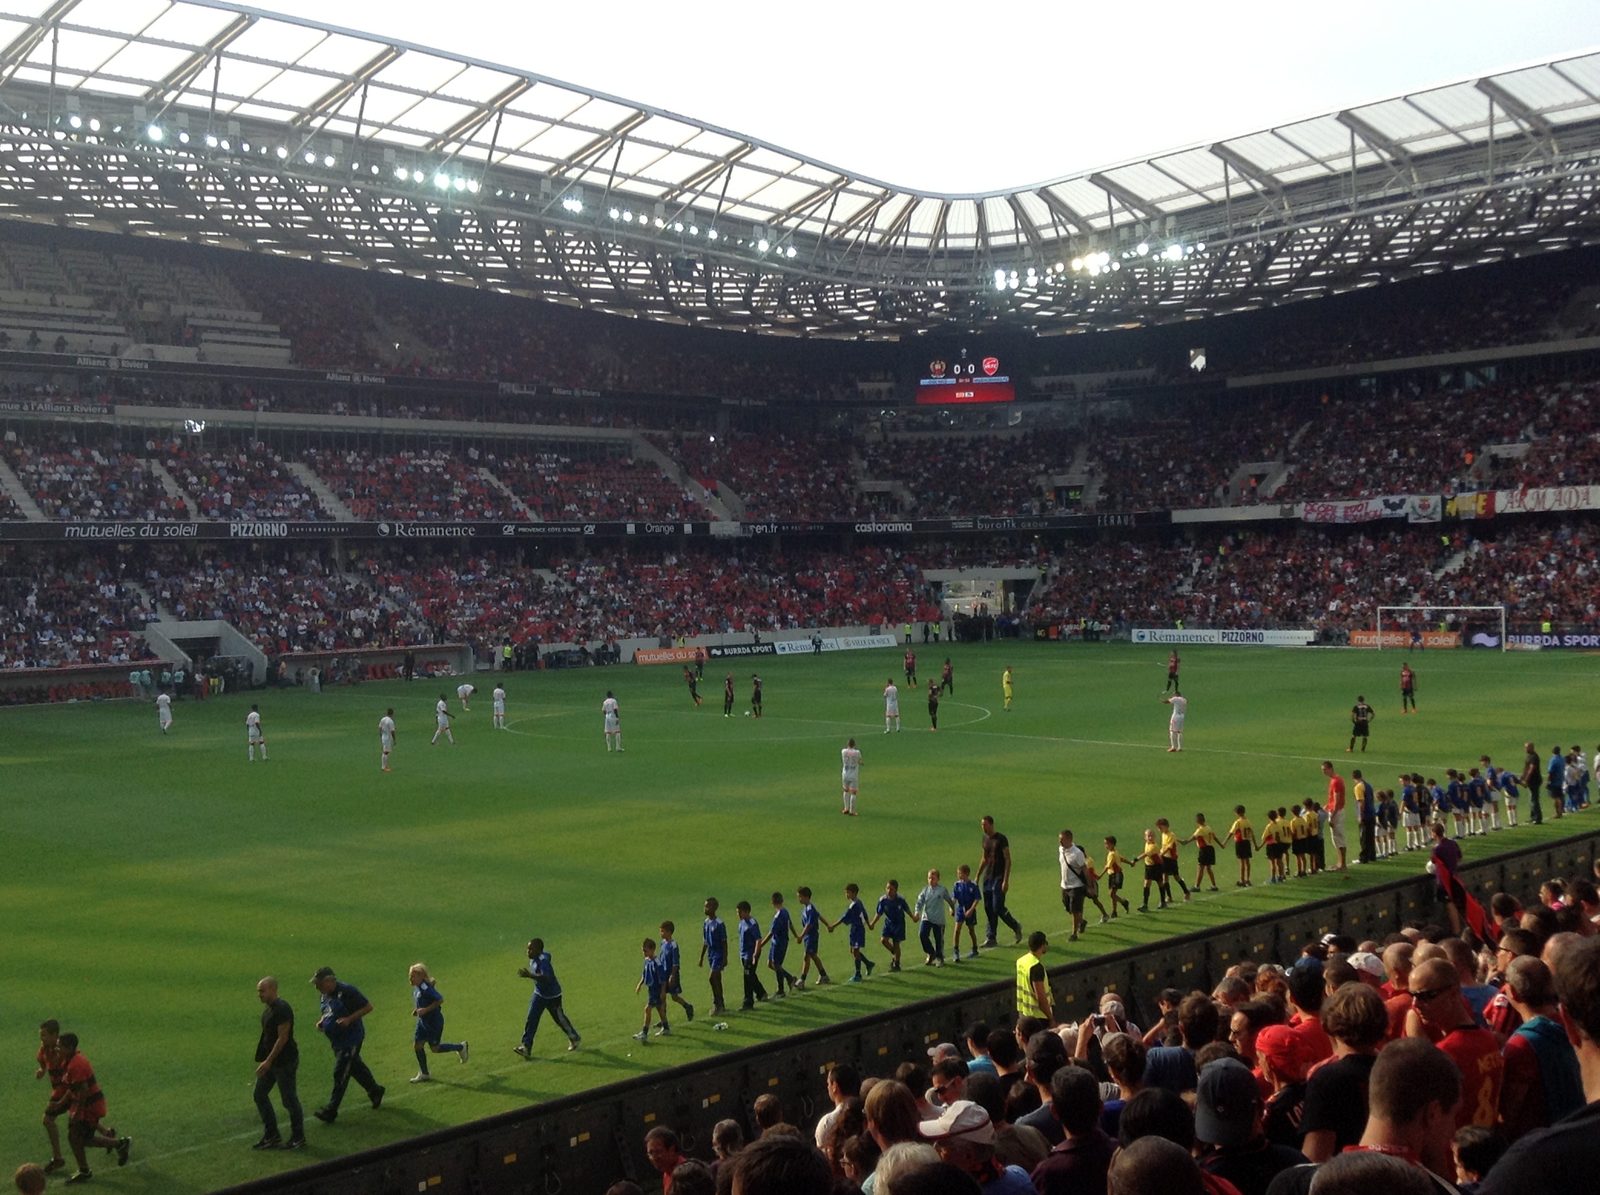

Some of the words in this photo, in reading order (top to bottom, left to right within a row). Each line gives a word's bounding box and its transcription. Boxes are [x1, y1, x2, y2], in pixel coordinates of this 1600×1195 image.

[77, 357, 107, 367] Allianz
[121, 360, 149, 369] Riviera
[954, 364, 961, 375] 0
[968, 364, 975, 374] 0
[64, 524, 136, 538] mutuelles
[139, 524, 160, 537] du
[163, 524, 199, 537] soleil
[230, 523, 288, 537] PIZZORNO
[395, 523, 476, 537] Rémanence
[645, 523, 675, 535] Orange
[855, 522, 913, 533] castorama
[1149, 630, 1215, 642] Rémanence
[1221, 631, 1264, 643] PIZZORNO
[1427, 635, 1456, 646] soleil
[724, 646, 750, 656] BURRDA
[753, 645, 773, 654] SPORT
[638, 652, 674, 663] mutuelles
